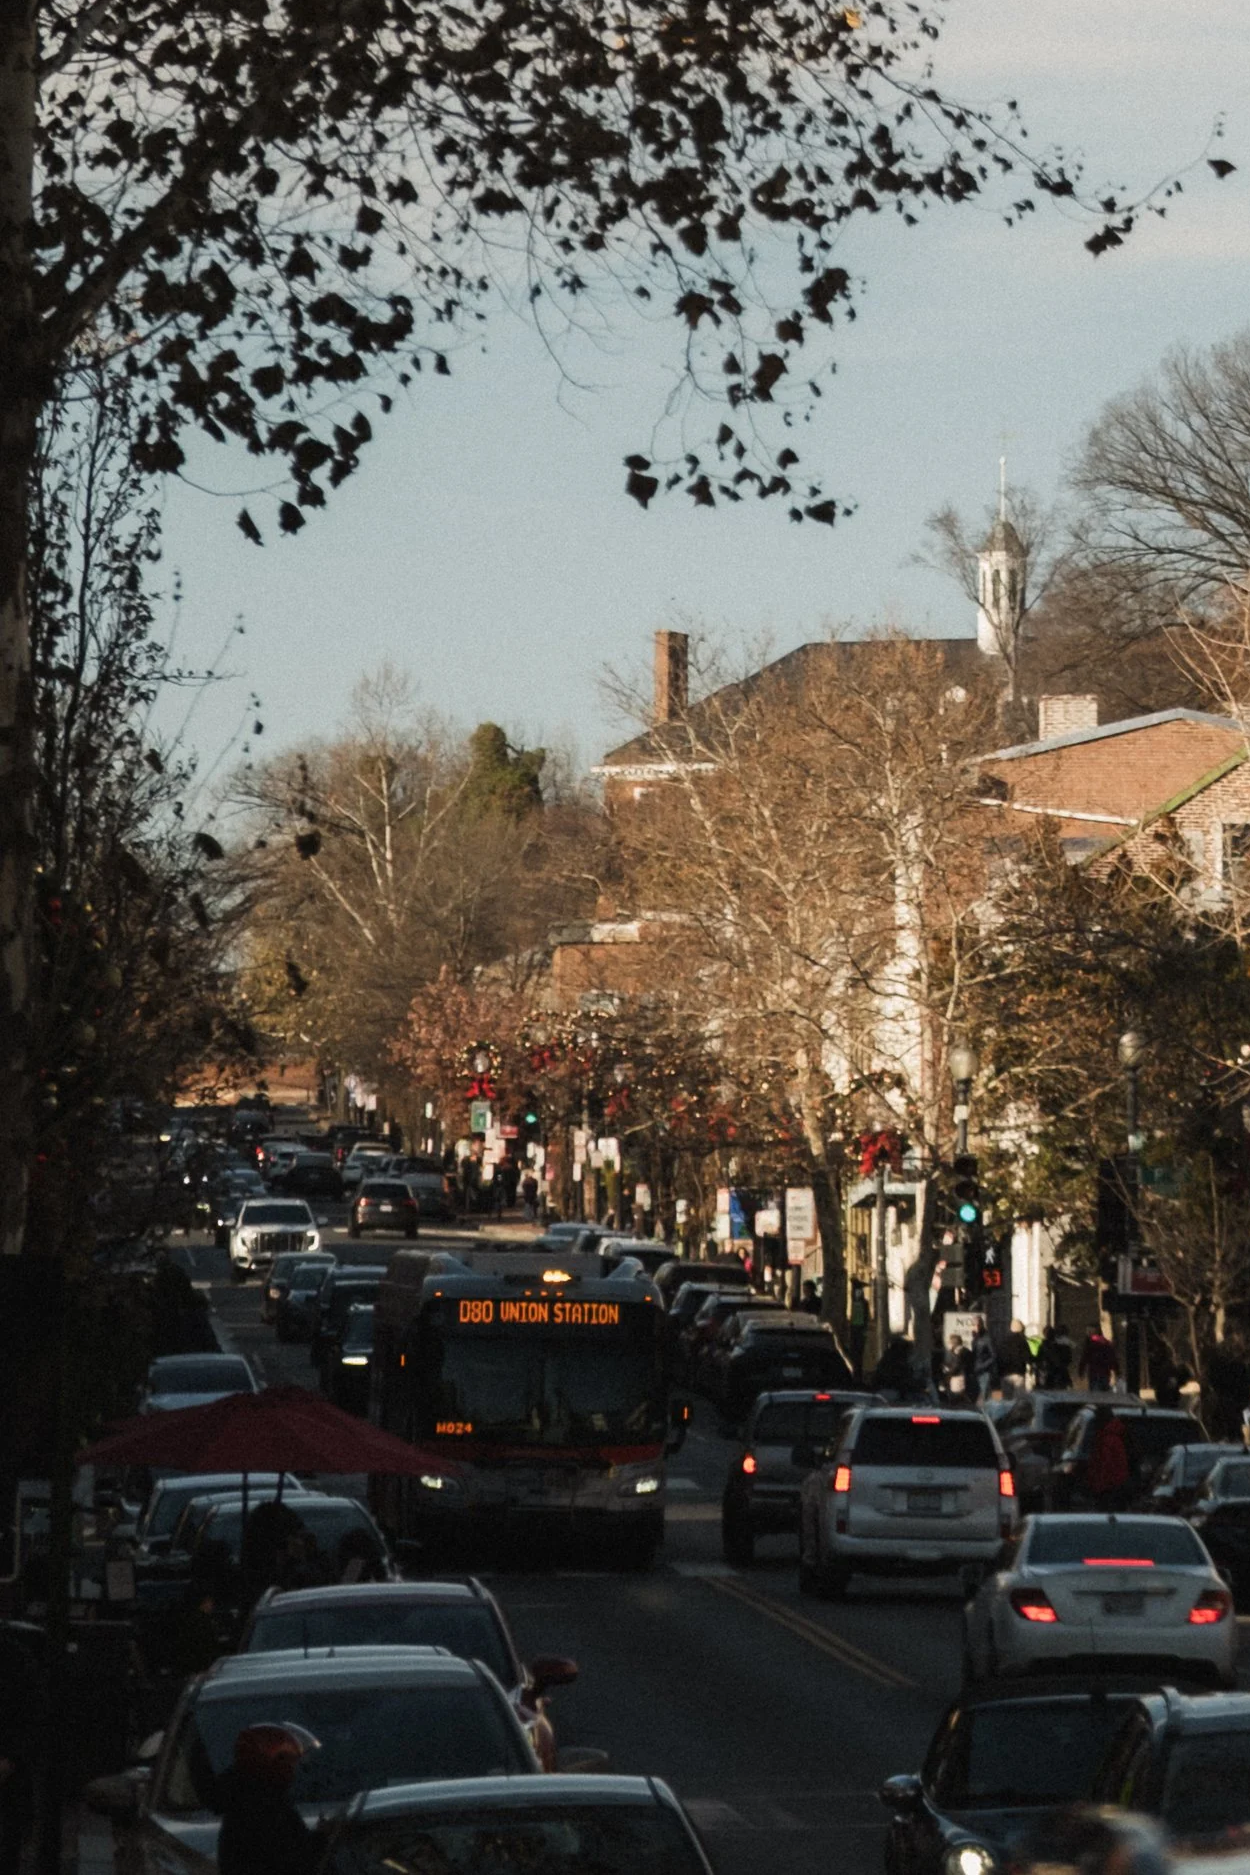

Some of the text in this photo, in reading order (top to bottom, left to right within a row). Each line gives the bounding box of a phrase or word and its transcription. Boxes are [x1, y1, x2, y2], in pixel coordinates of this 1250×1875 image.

[459, 1300, 619, 1325] D80 UNION STATION
